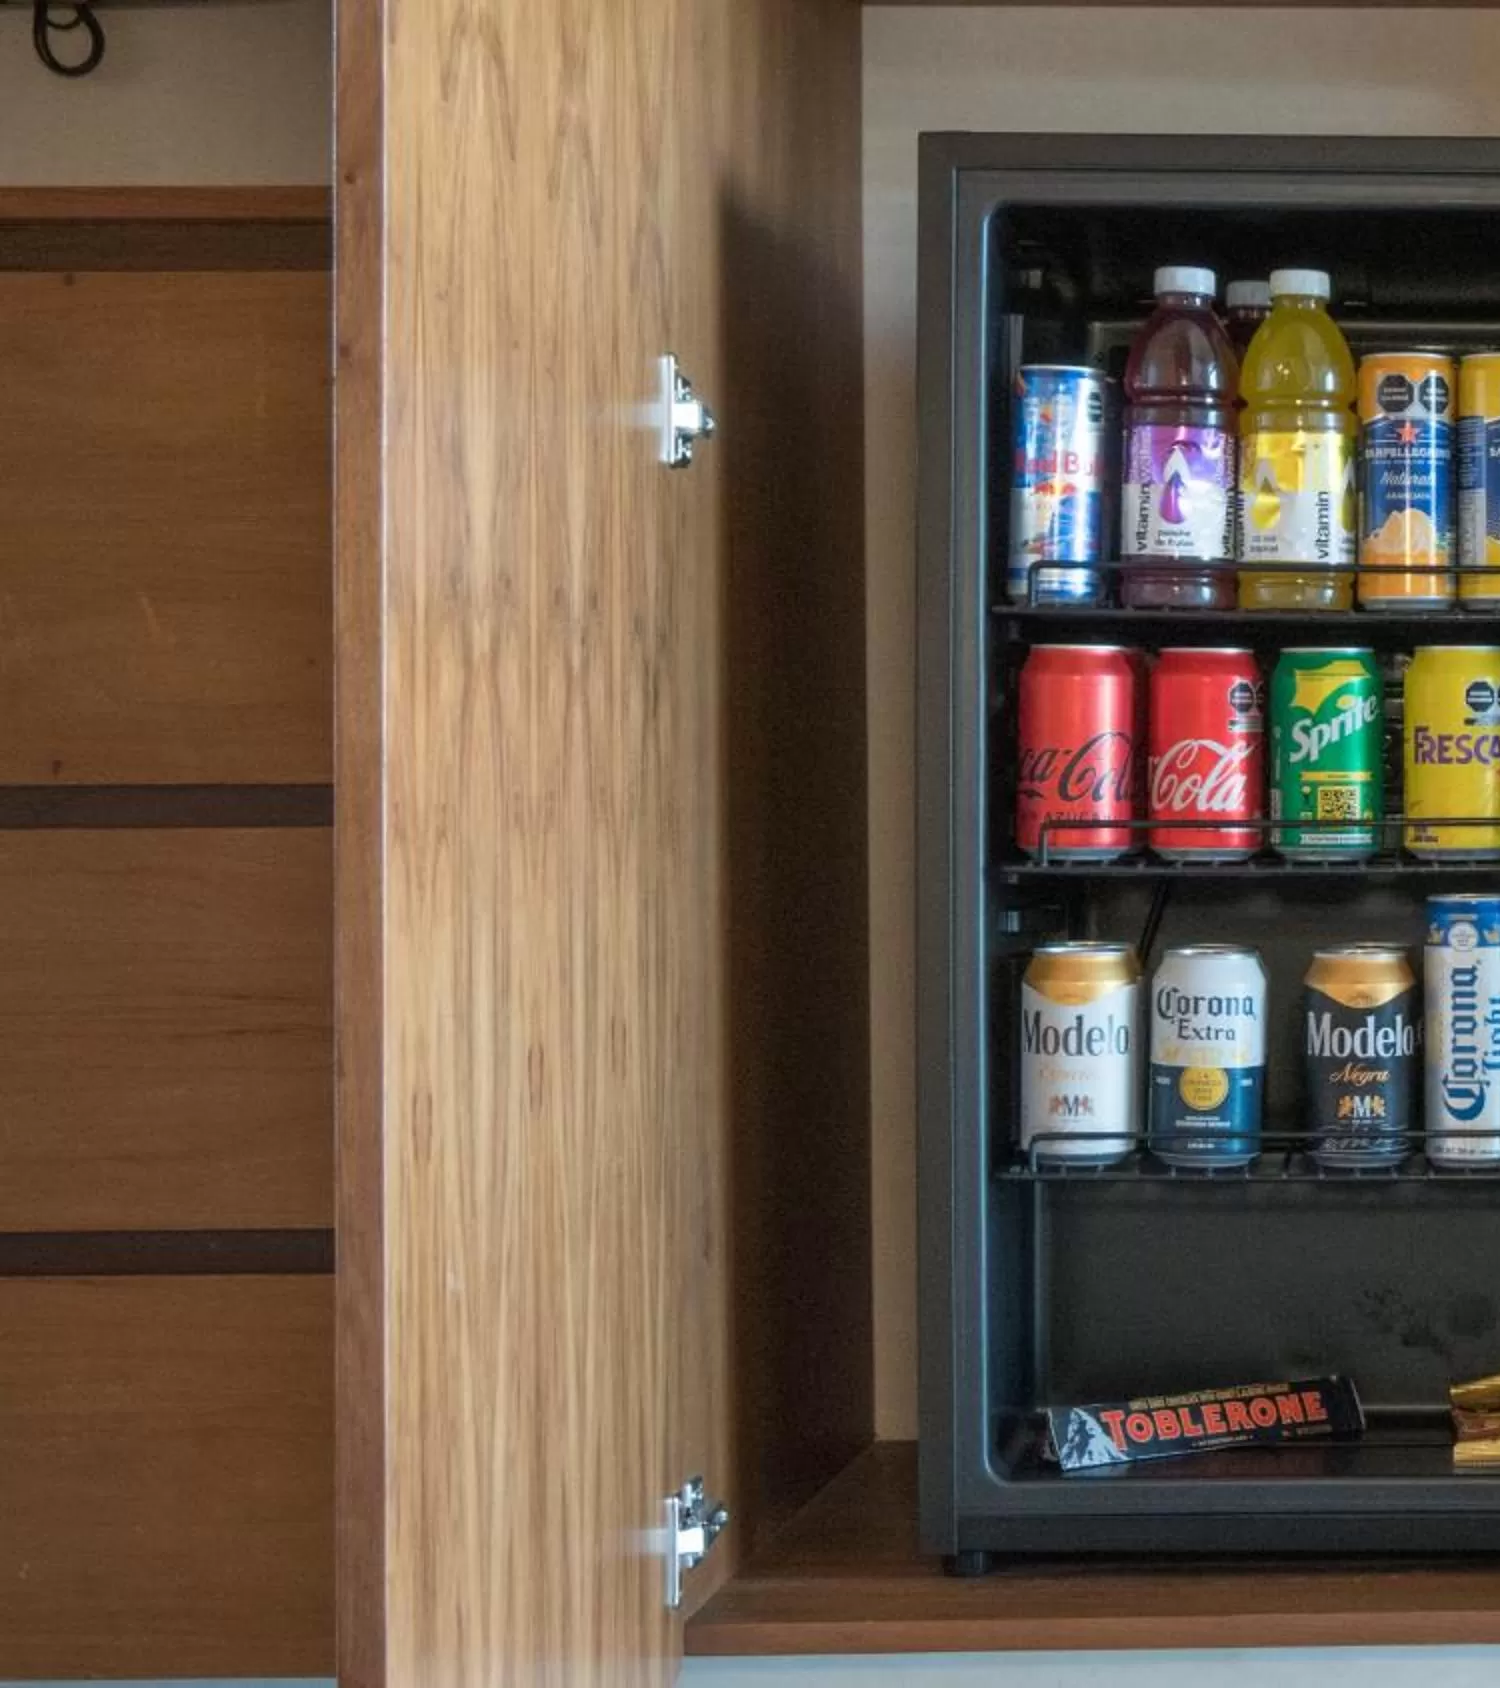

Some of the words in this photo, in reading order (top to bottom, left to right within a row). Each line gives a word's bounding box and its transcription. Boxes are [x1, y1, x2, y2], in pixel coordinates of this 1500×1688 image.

[1135, 483, 1151, 552] vitamin
[1314, 491, 1329, 560] vitamin
[1289, 695, 1378, 763] Sprite
[1157, 985, 1257, 1020] Corona
[1172, 1018, 1237, 1042] Extra
[1023, 1009, 1130, 1057] Modelo
[1307, 1011, 1415, 1058] Modelo
[1442, 964, 1491, 1122] Corona
[1329, 1062, 1391, 1087] Negra
[1101, 1390, 1329, 1453] TOBLERONE
